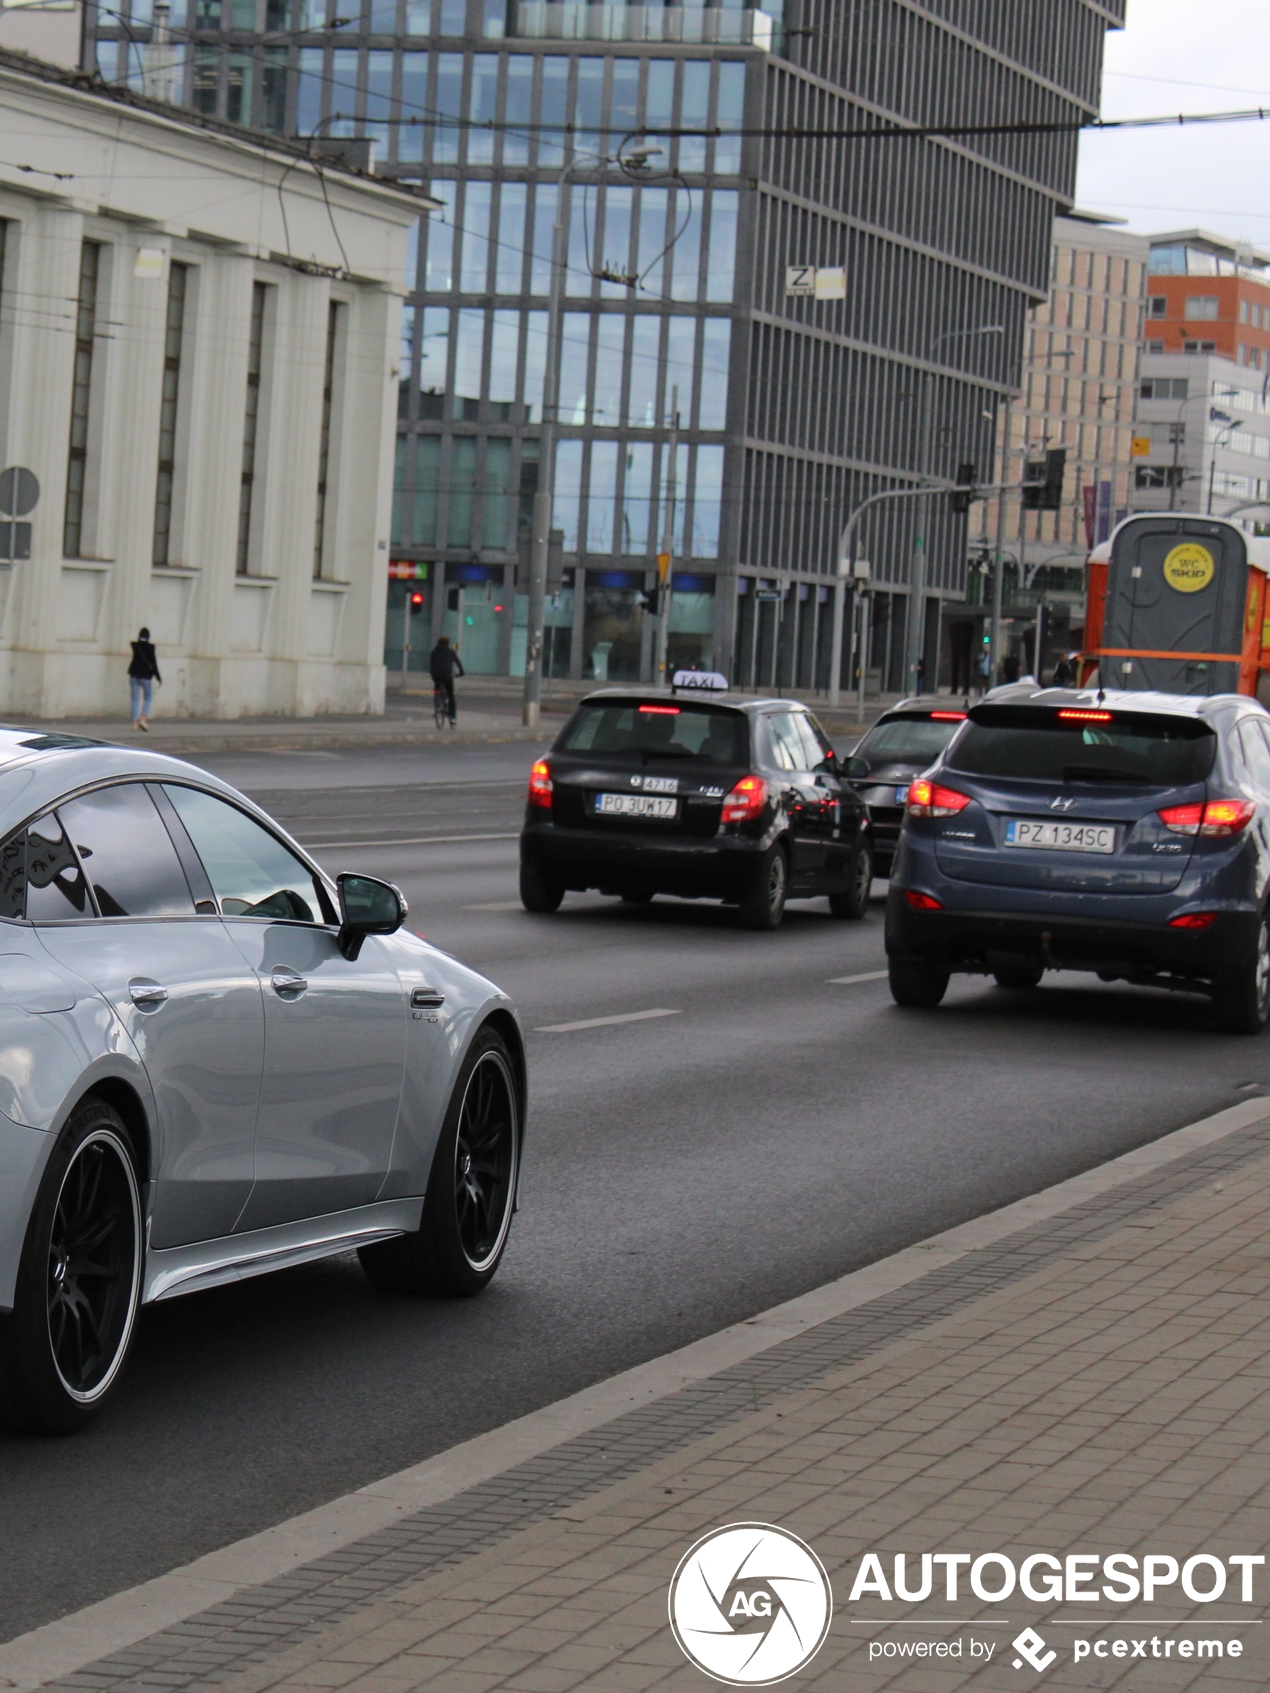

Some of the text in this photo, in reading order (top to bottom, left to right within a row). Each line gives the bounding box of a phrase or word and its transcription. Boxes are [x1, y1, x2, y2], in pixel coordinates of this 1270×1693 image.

[792, 268, 809, 286] Z
[1179, 559, 1199, 569] WC
[1171, 569, 1206, 578] SKIP
[680, 675, 714, 688] TAXI
[645, 781, 676, 792] 4716
[1018, 823, 1109, 847] PZ 134SC
